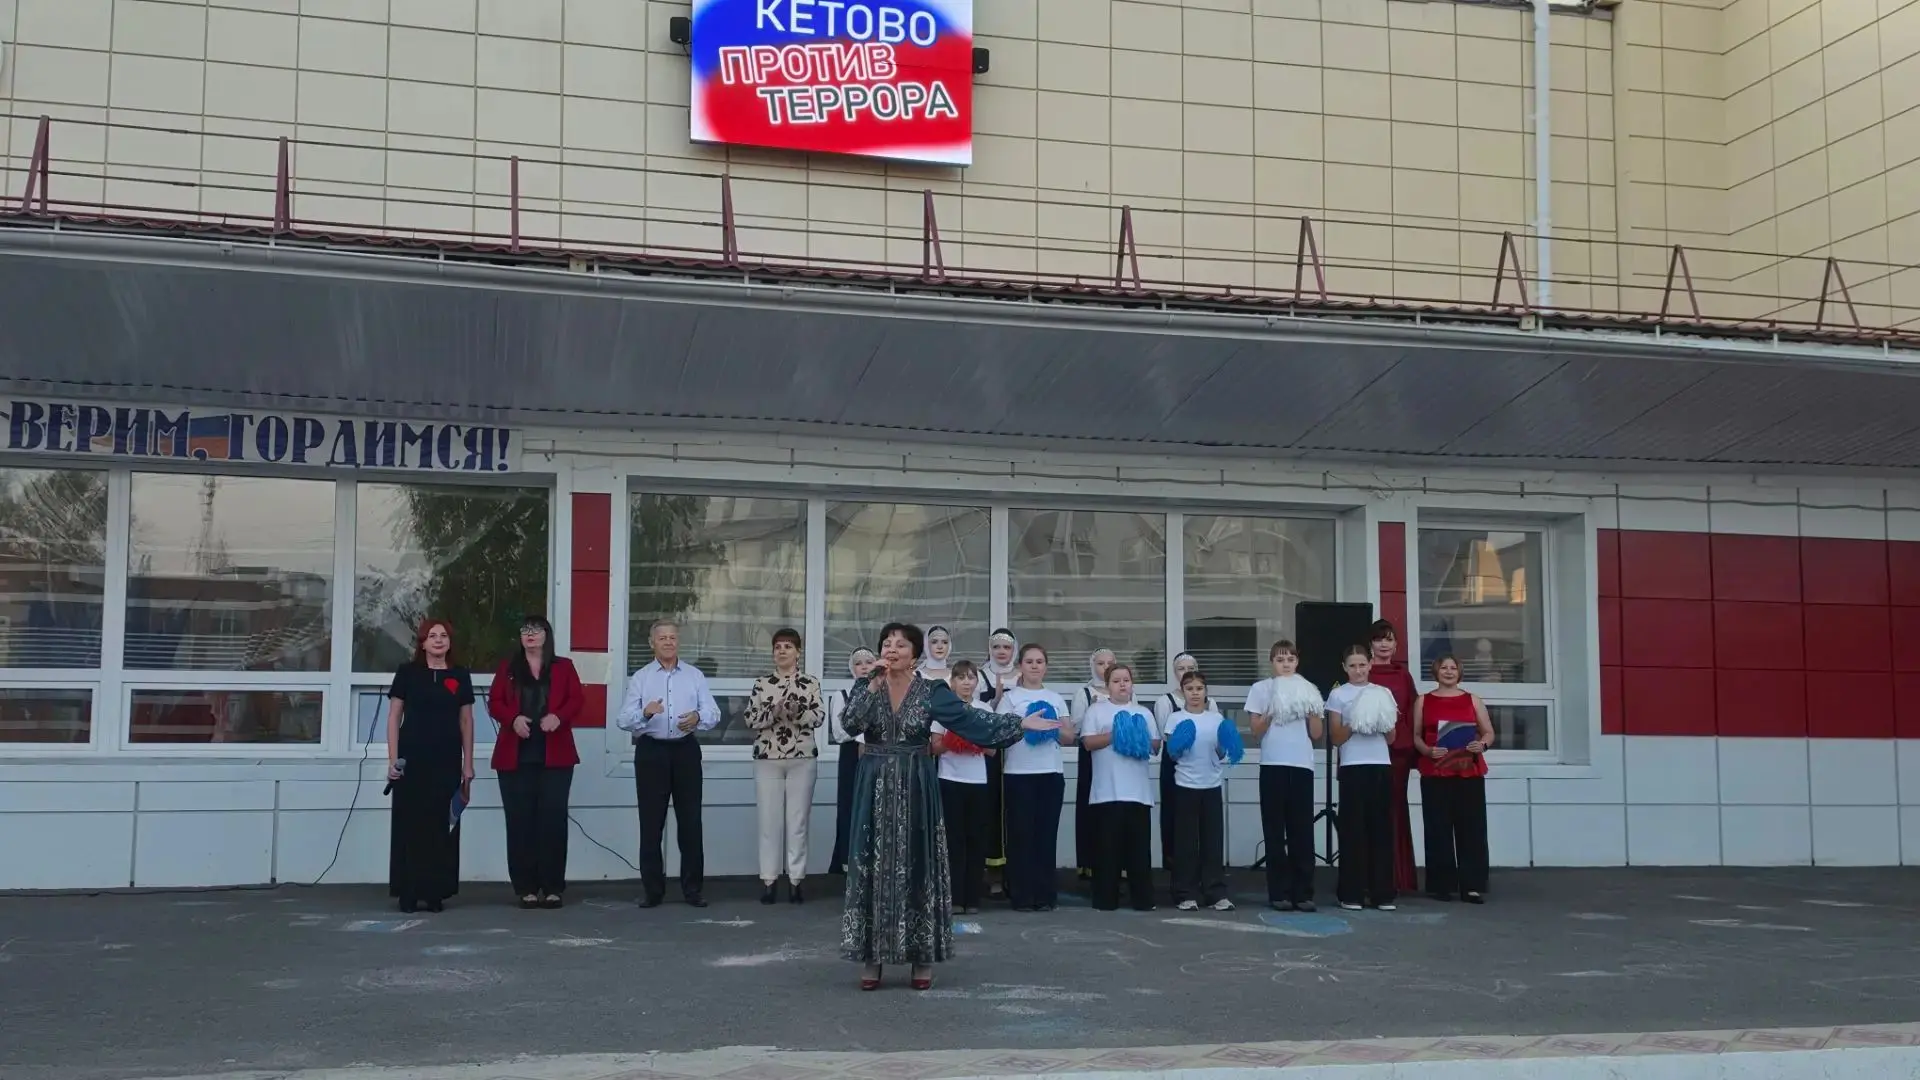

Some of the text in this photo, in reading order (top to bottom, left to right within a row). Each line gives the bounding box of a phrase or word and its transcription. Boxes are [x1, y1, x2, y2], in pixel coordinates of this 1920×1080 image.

[756, 0, 936, 46] КЕТОВО
[719, 42, 897, 84] ПРОТИВ
[757, 81, 958, 124] ТЕРРОРА
[228, 413, 510, 472] ГОРДИМСЯ!
